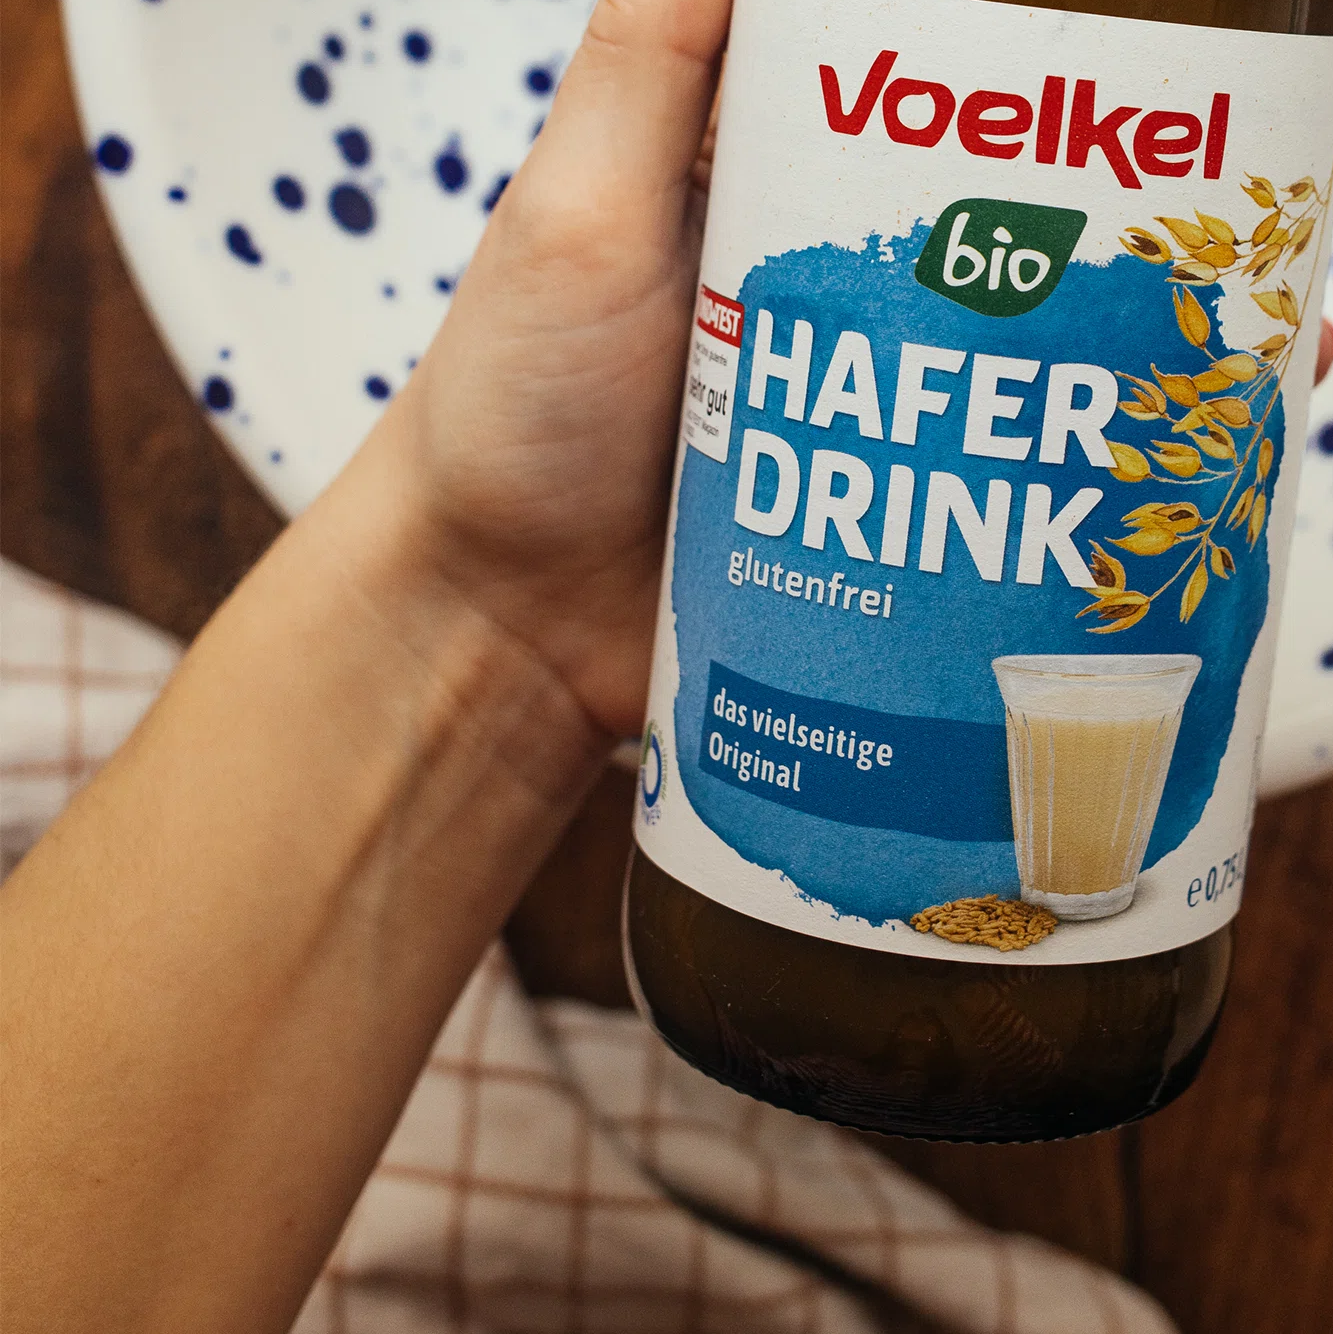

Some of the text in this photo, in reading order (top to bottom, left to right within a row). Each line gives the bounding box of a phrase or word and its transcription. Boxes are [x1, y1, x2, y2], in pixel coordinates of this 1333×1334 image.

[819, 50, 1230, 189] Voelkel
[943, 213, 1050, 293] bio
[706, 388, 728, 416] gut
[747, 309, 1120, 468] HAFER
[734, 427, 1103, 588] DRINK
[728, 548, 893, 618] glutenfrei
[709, 731, 801, 791] Original
[713, 687, 893, 770] das vielseitige
